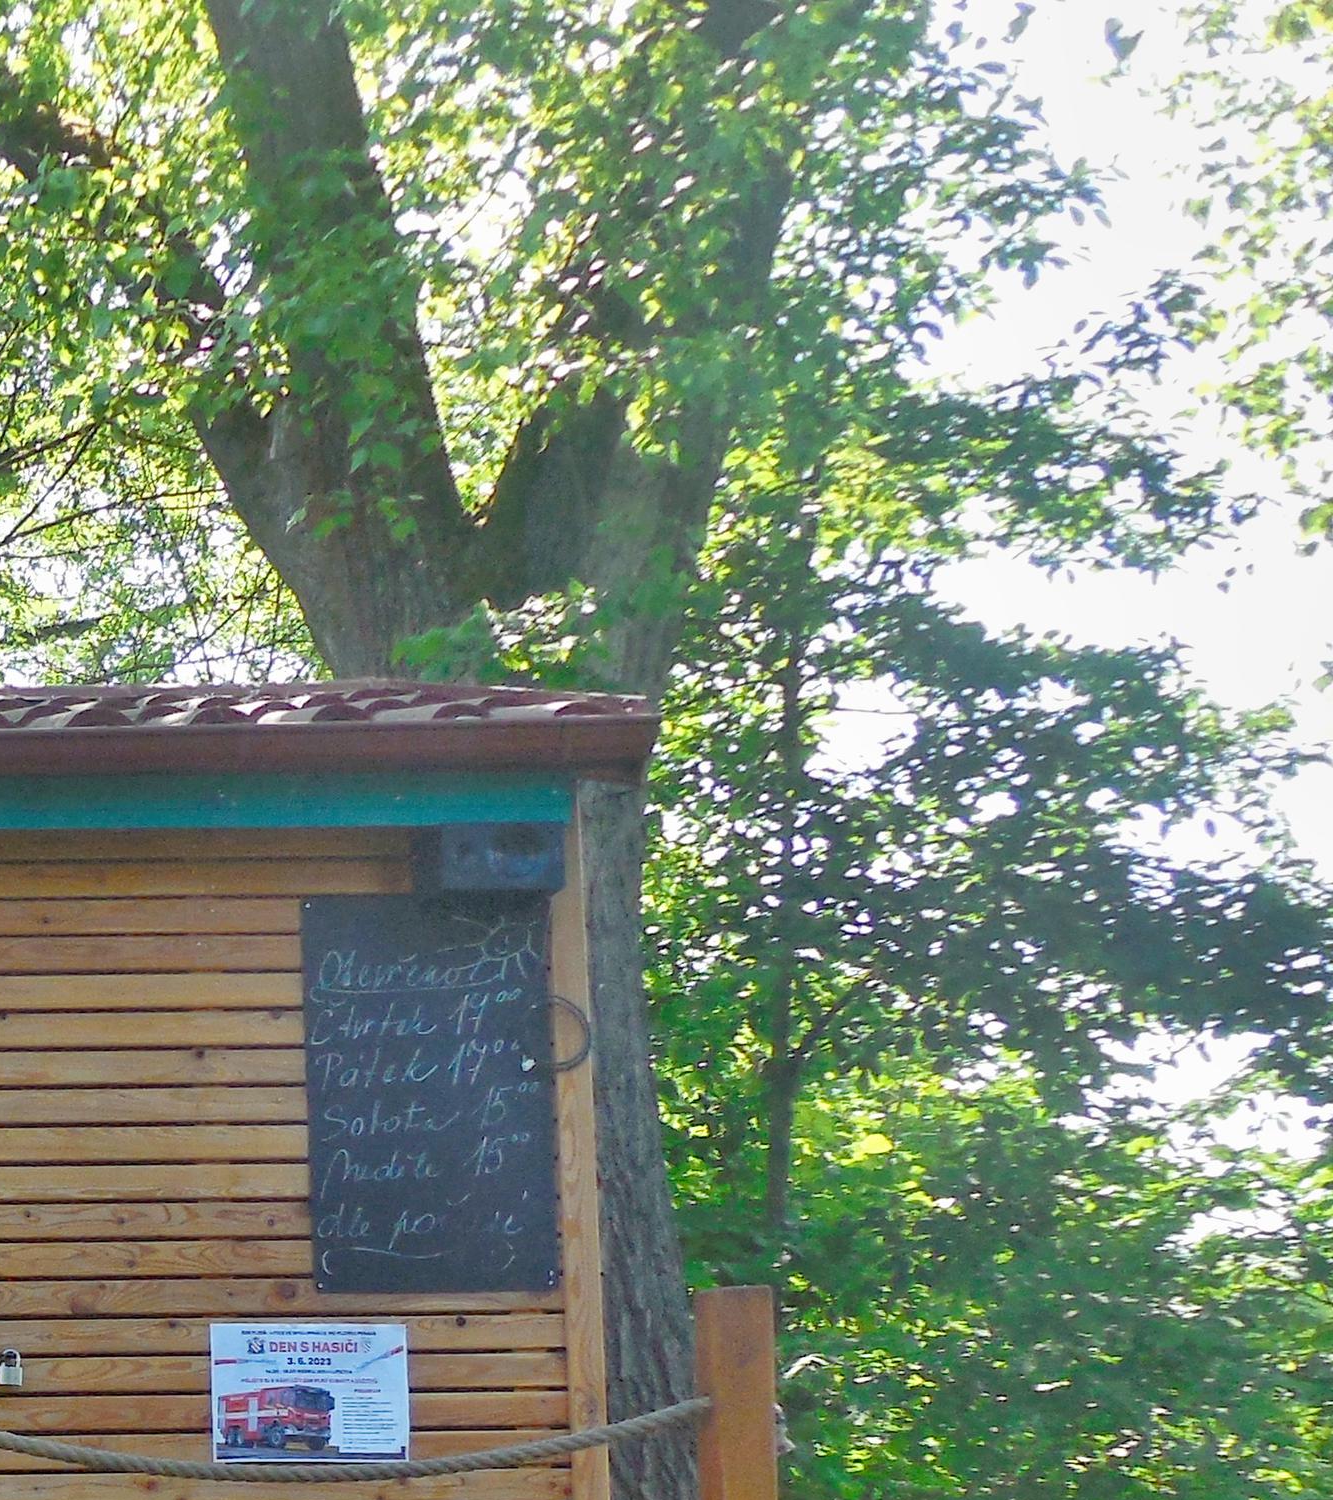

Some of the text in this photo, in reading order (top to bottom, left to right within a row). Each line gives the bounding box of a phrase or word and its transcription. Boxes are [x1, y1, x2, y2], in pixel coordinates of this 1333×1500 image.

[315, 1047, 439, 1091] Pátek
[269, 1338, 358, 1353] DEN S HASIČI
[308, 1357, 331, 1366] 2023
